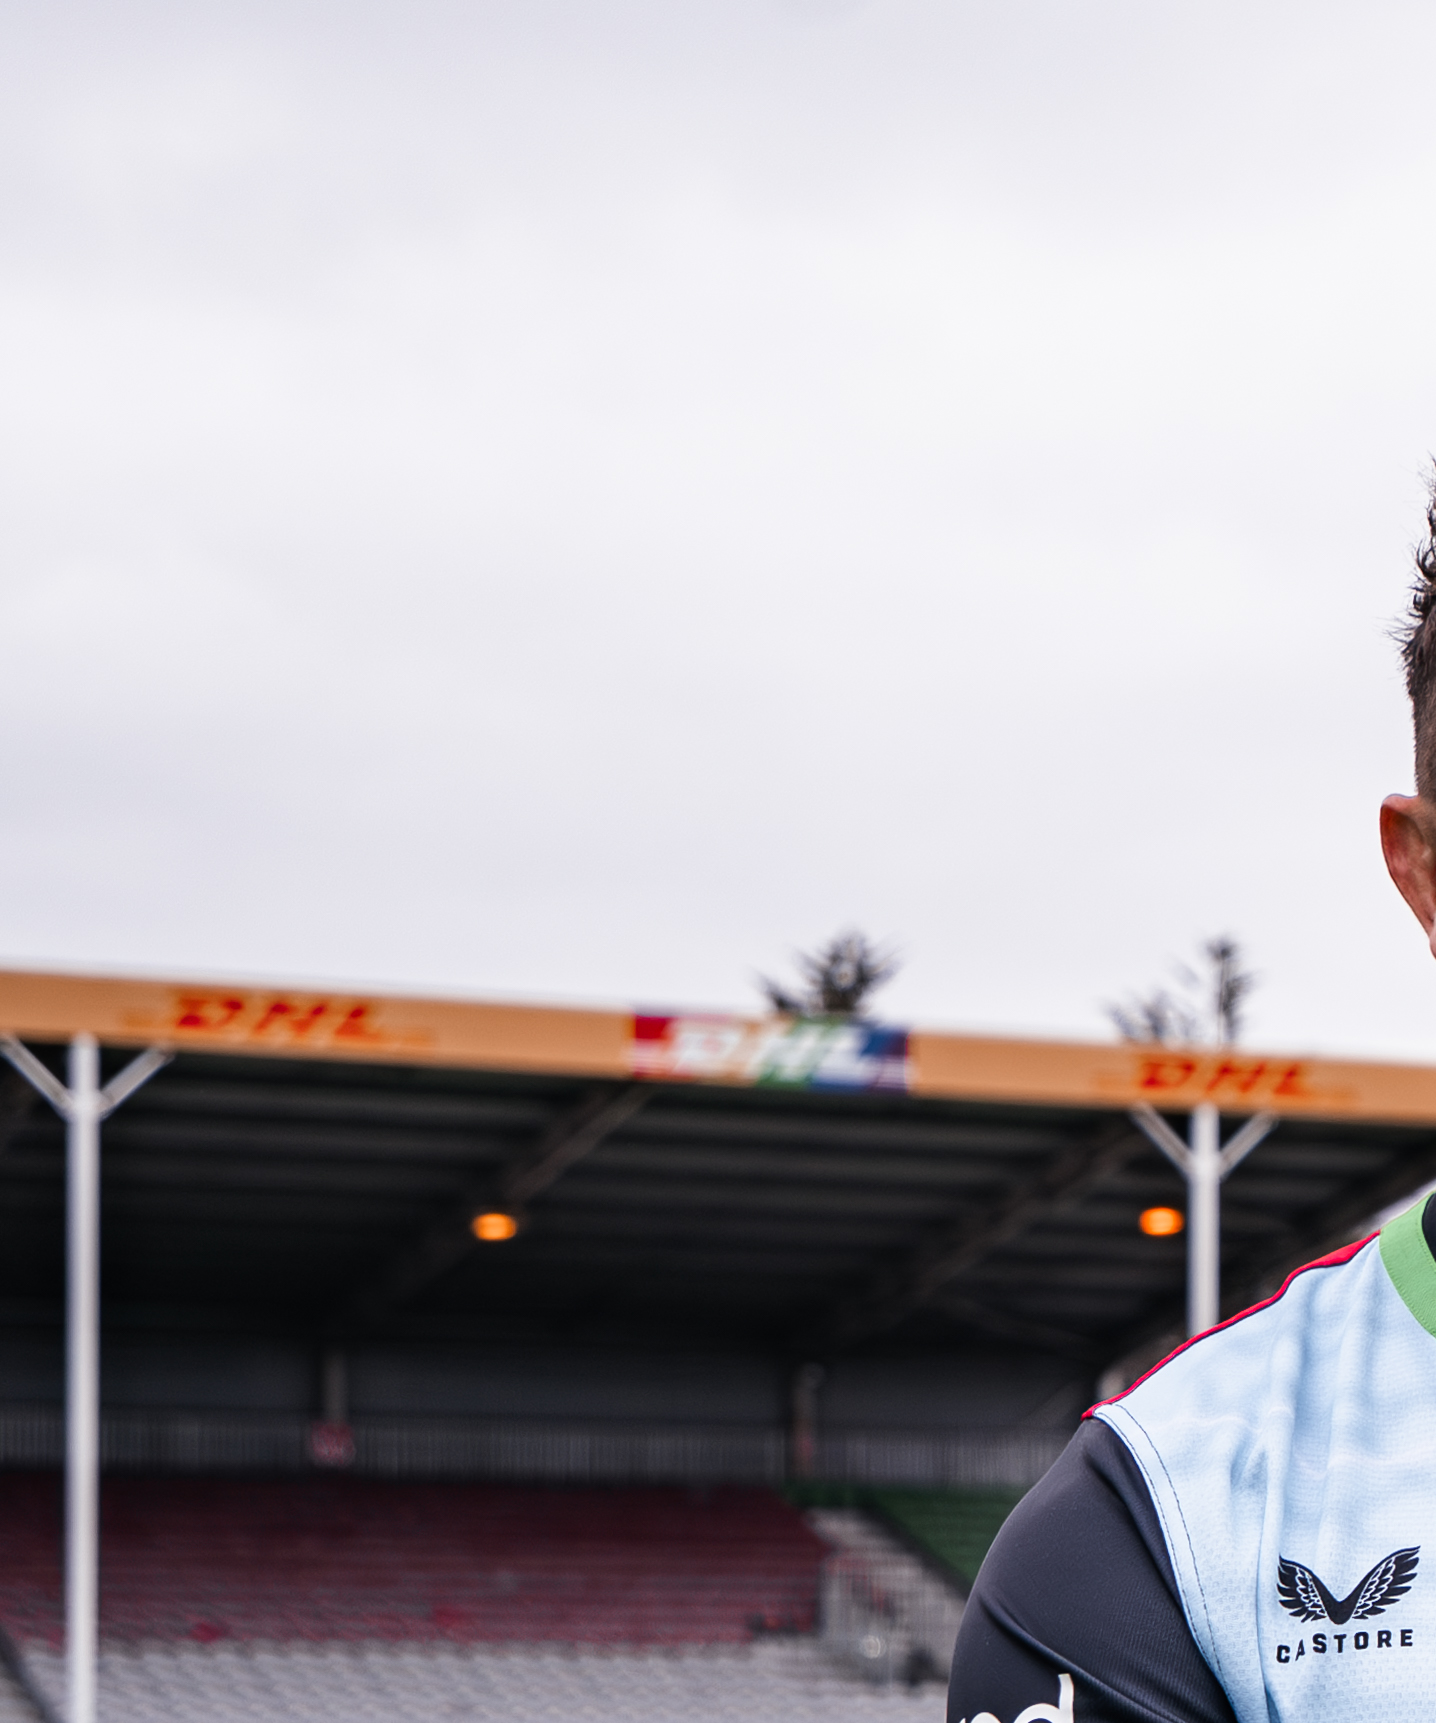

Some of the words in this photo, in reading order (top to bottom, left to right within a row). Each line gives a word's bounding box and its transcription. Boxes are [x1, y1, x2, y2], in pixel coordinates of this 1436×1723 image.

[174, 988, 382, 1042] DHL
[1140, 1056, 1310, 1097] DHL
[1276, 1629, 1413, 1663] CASTORE
